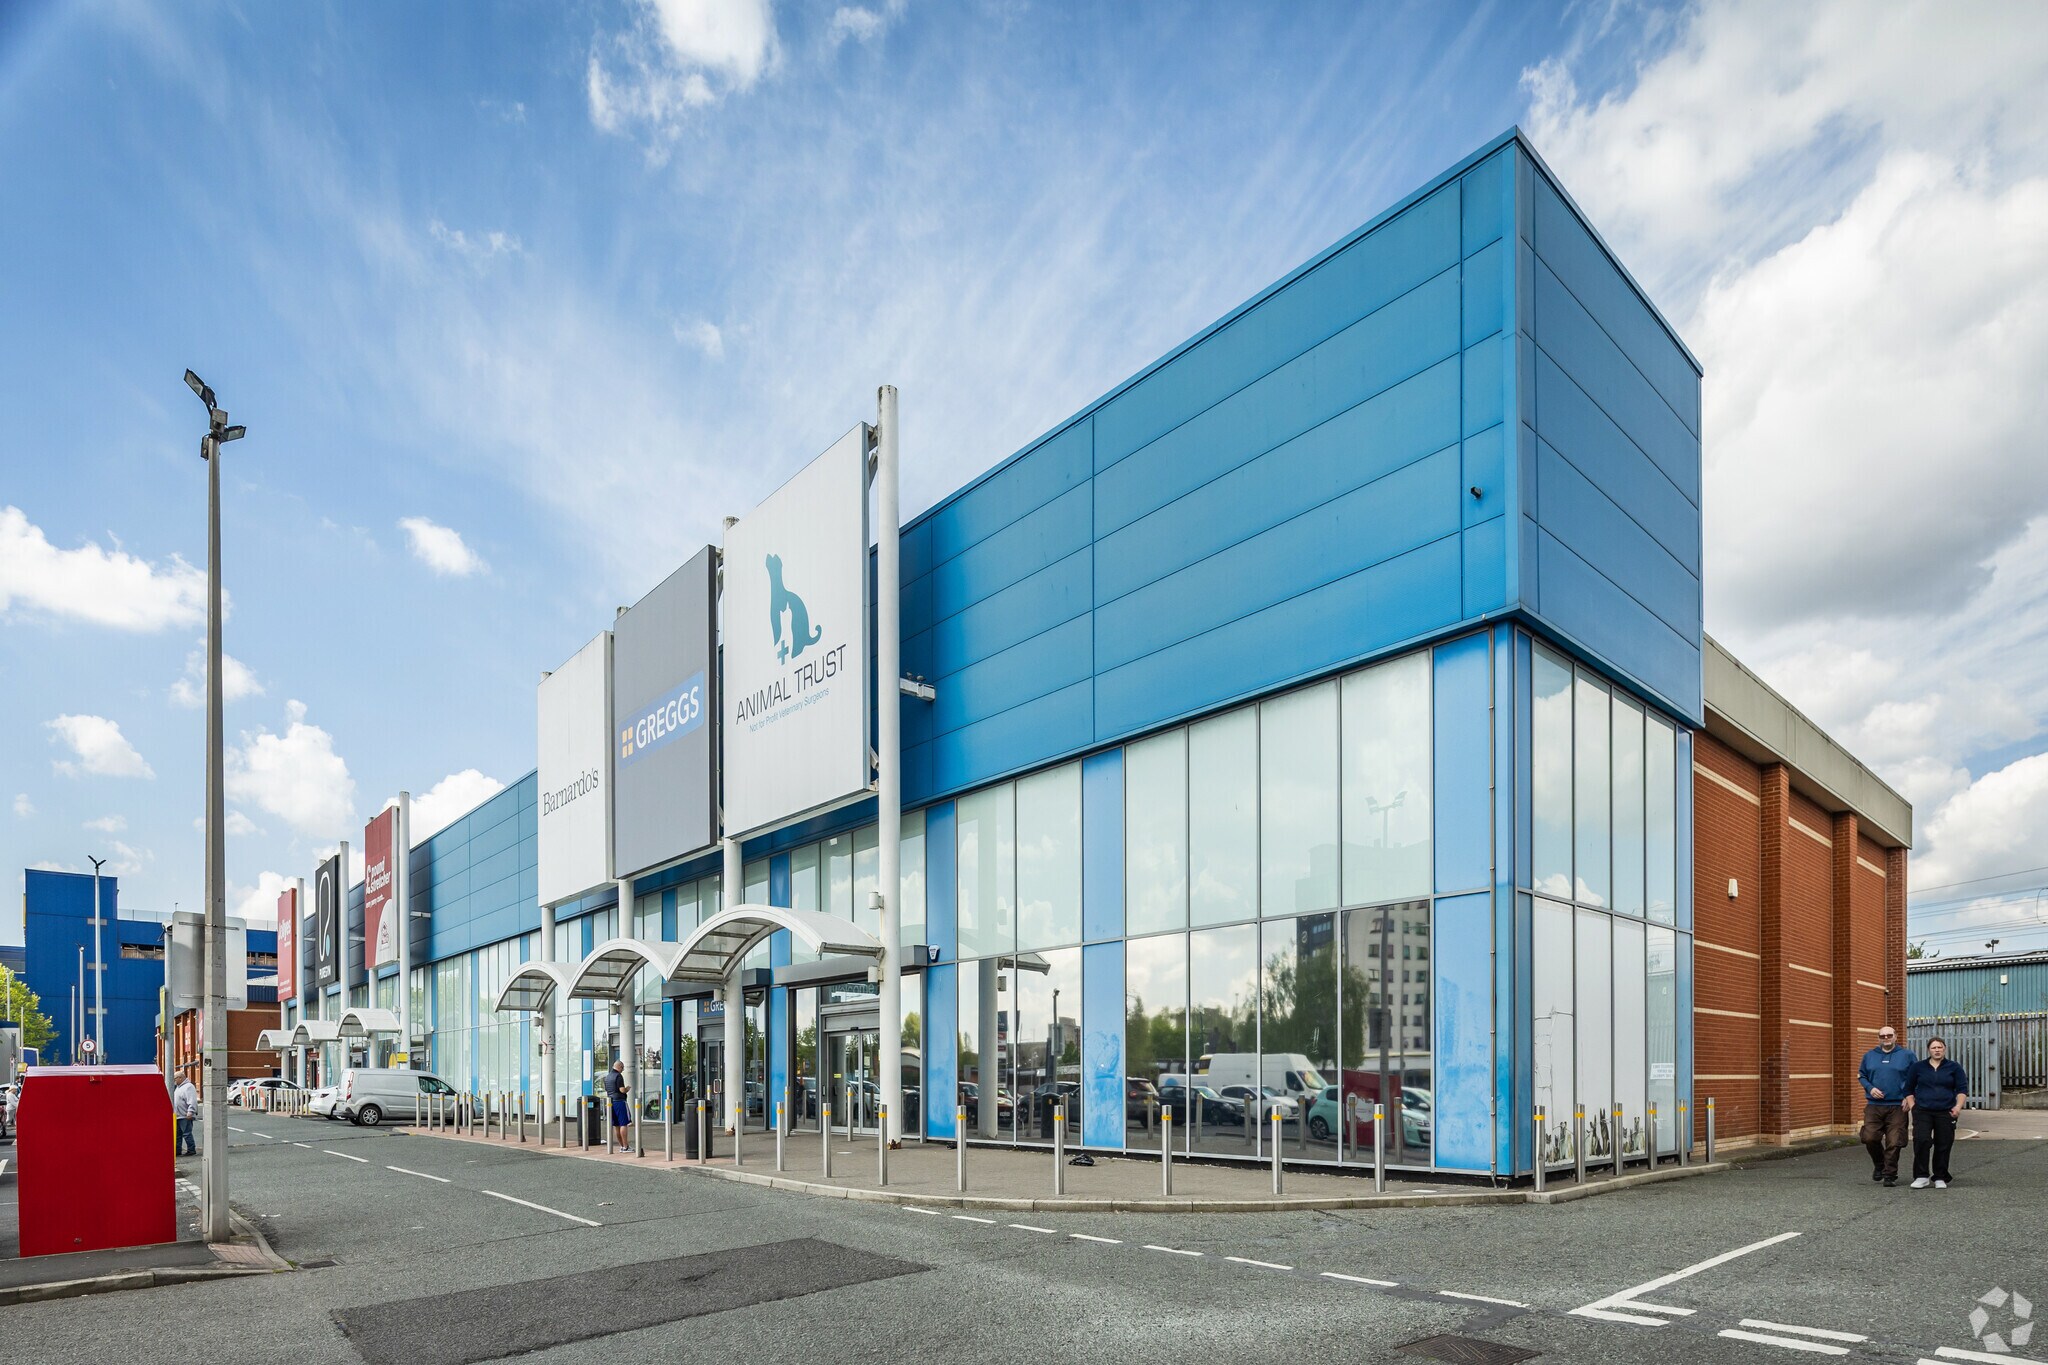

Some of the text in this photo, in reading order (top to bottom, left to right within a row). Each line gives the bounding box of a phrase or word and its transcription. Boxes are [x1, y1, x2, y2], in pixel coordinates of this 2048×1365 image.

[735, 643, 847, 725] ANIMAL TRUST
[766, 712, 779, 725] Profit
[779, 701, 804, 719] Veterinary
[804, 688, 830, 706] Surgeons
[635, 685, 700, 750] GREGGS
[543, 768, 600, 817] Barnardo's
[710, 1000, 725, 1012] GRE
